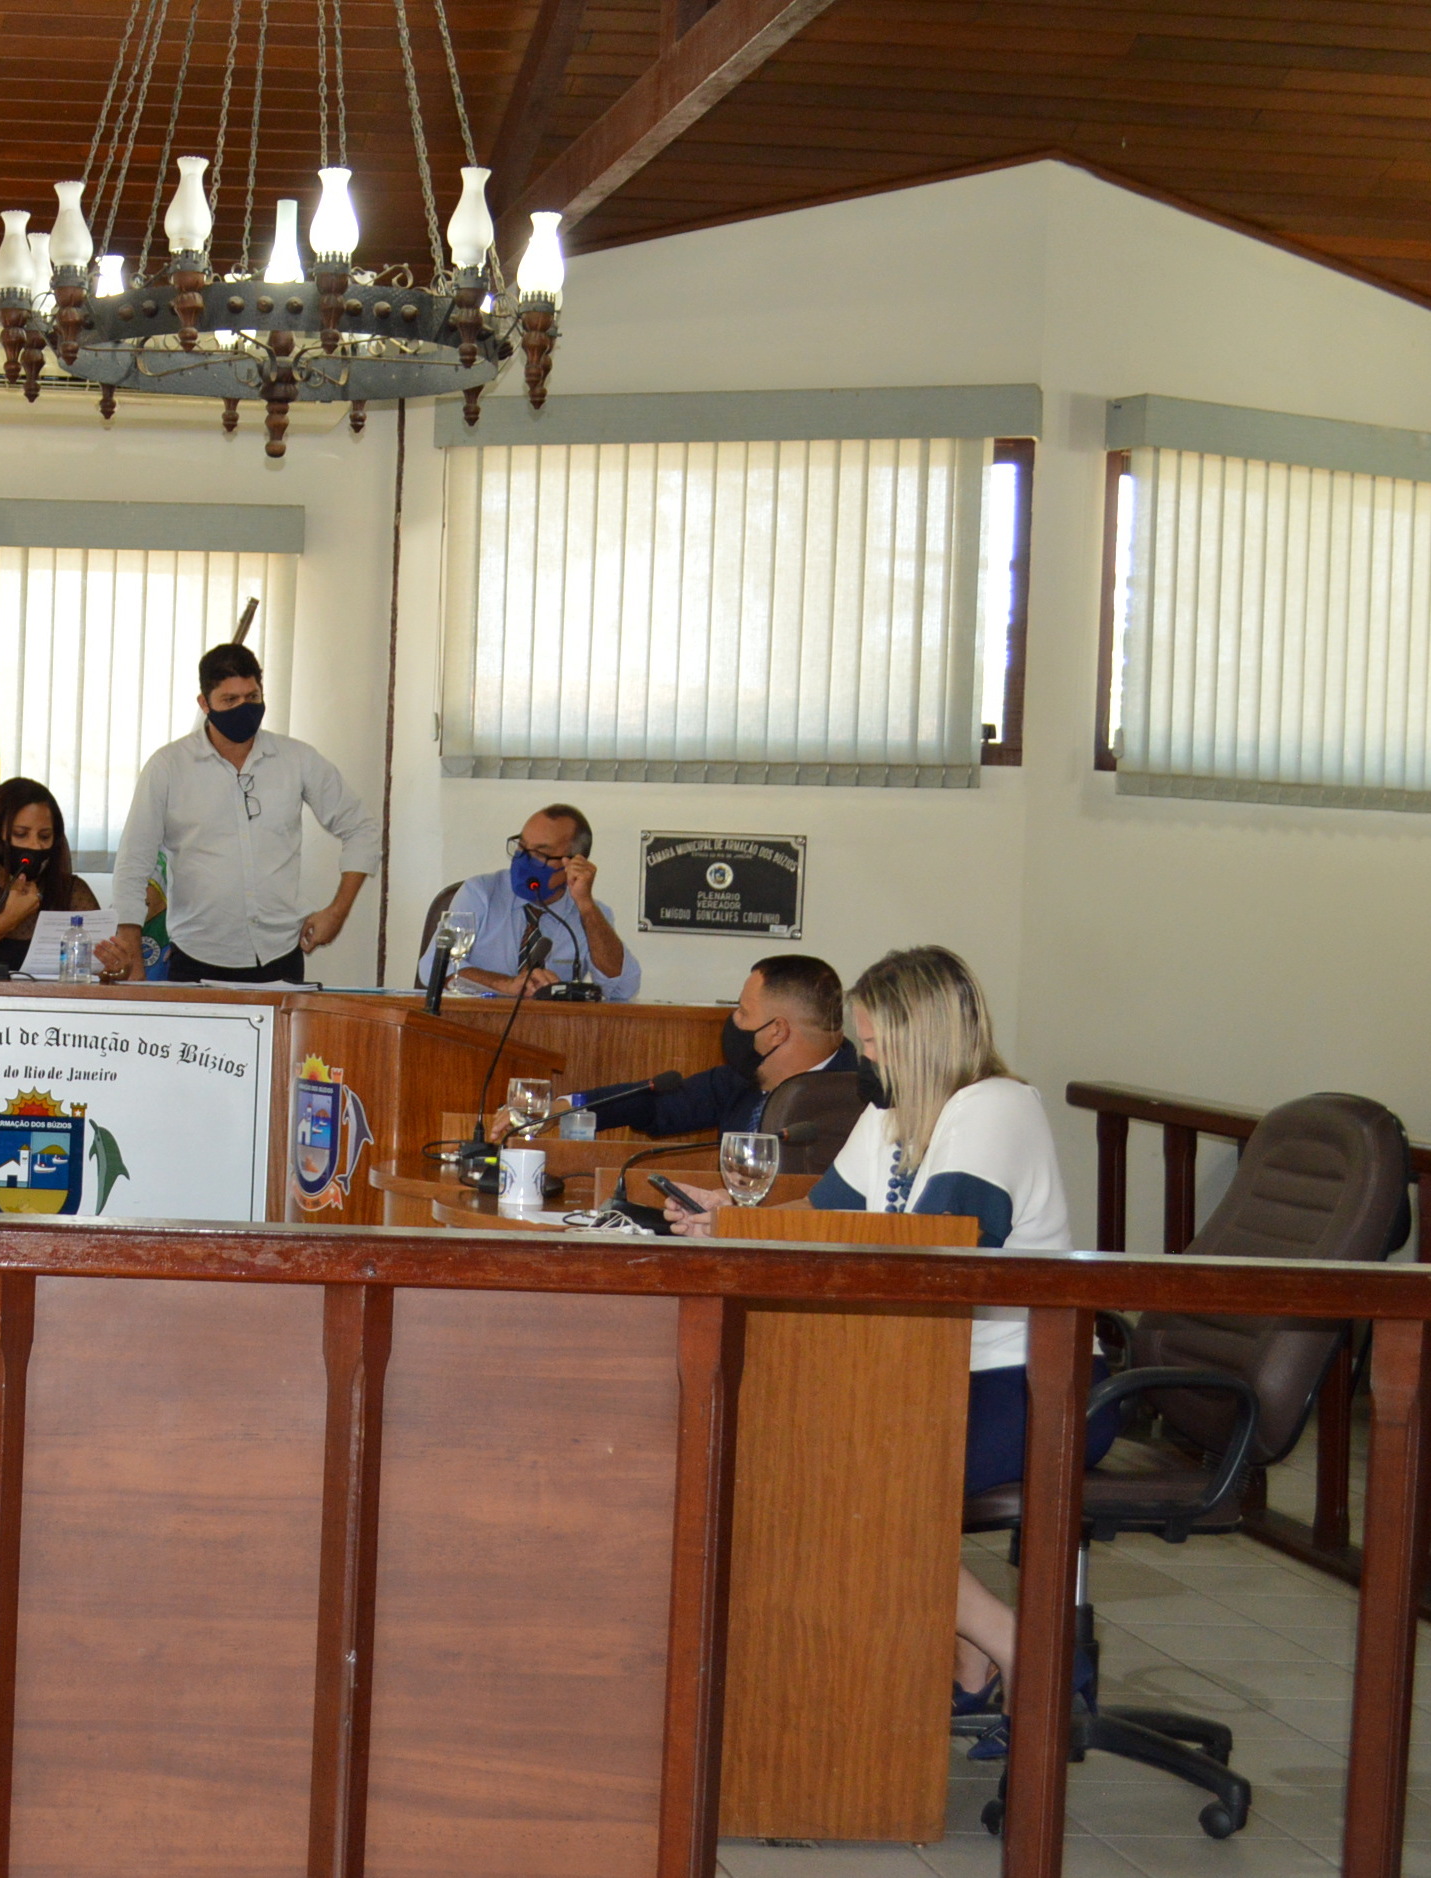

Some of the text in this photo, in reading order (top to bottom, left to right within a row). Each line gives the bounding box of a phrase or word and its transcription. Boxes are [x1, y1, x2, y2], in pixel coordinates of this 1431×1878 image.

[714, 839, 724, 850] DE
[697, 890, 741, 901] PLENÁRIO
[696, 900, 741, 910] VEREADOR
[696, 909, 739, 923] GONÇALVES
[742, 911, 781, 924] COUTINHO
[19, 1027, 40, 1046] de
[44, 1026, 130, 1057] Armação
[137, 1037, 171, 1059] dos
[176, 1042, 248, 1078] Búzios
[3, 1065, 19, 1079] do
[24, 1065, 46, 1080] Rio
[47, 1066, 63, 1080] de
[66, 1067, 117, 1082] Janeiro
[46, 1120, 72, 1129] BÚZIOS
